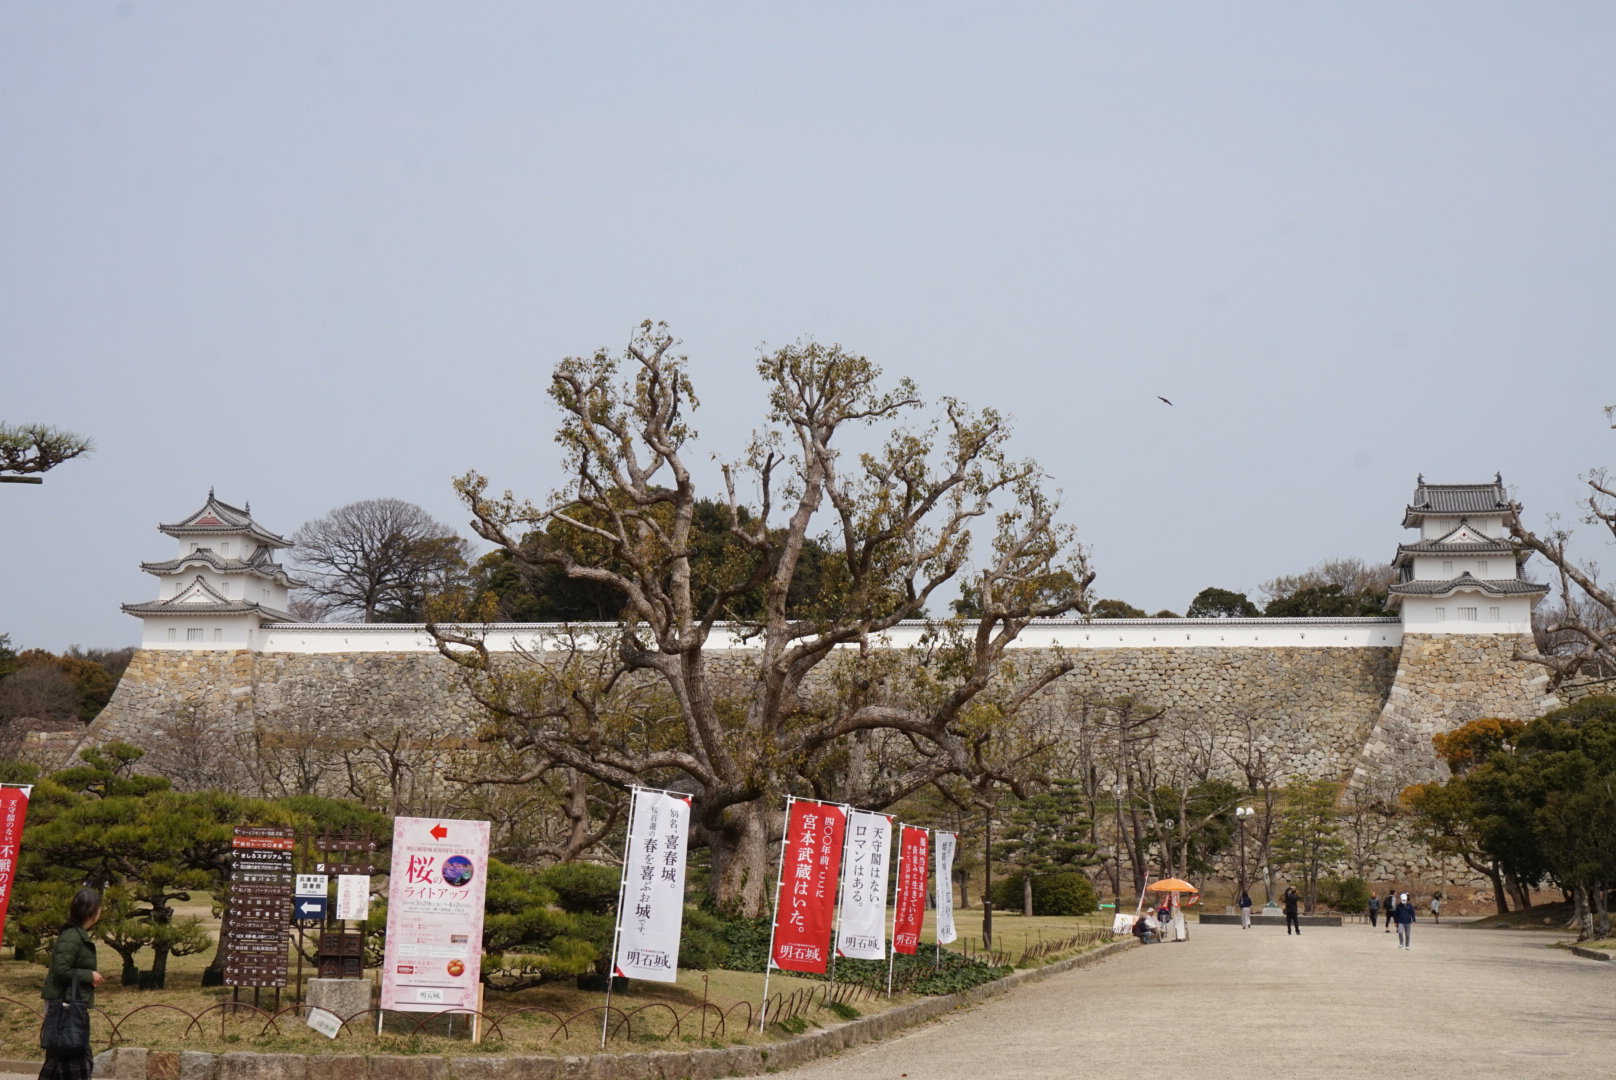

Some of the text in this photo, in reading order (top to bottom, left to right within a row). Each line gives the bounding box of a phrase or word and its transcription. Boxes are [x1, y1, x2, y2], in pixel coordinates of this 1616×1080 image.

[660, 808, 679, 889] 別名、喜春城。
[405, 855, 442, 885] 桜の
[790, 814, 818, 933] 宮本武蔵はいた。
[852, 825, 867, 907] ロマンはある。
[869, 827, 884, 909] 天守閣はない。
[404, 887, 471, 900] ライトアップ
[779, 944, 821, 962] 明石城
[845, 936, 880, 951] 明石城
[625, 951, 671, 969] 明石城
